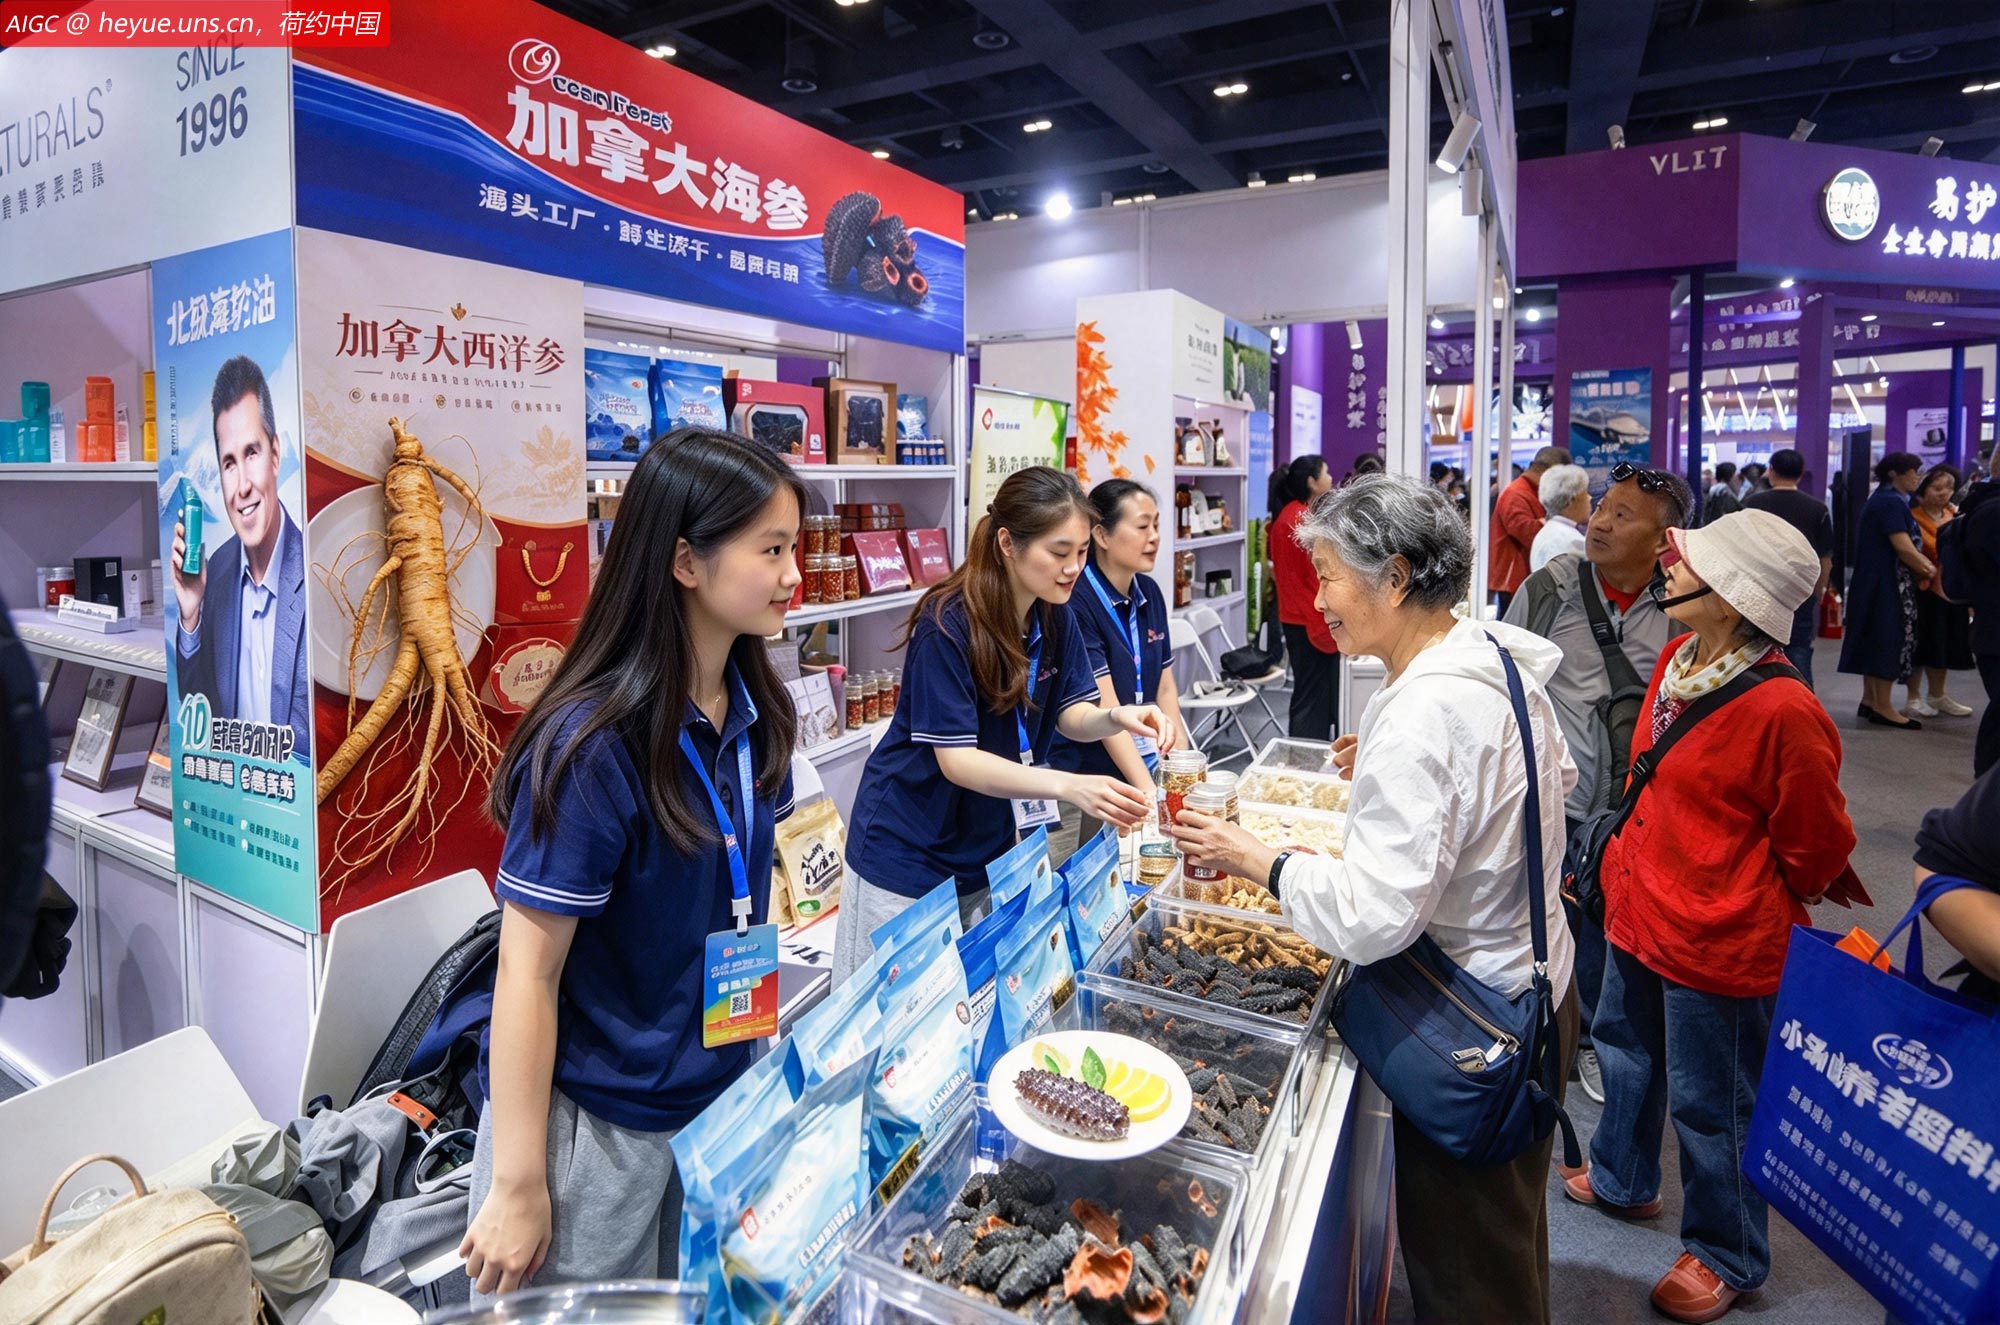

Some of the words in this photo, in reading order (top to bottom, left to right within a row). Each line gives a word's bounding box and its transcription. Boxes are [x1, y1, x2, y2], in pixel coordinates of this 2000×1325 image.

[0, 86, 104, 178] TURALS
[176, 86, 248, 157] 1996
[505, 85, 809, 230] 加拿大海参
[335, 312, 566, 376] 加拿大西洋参
